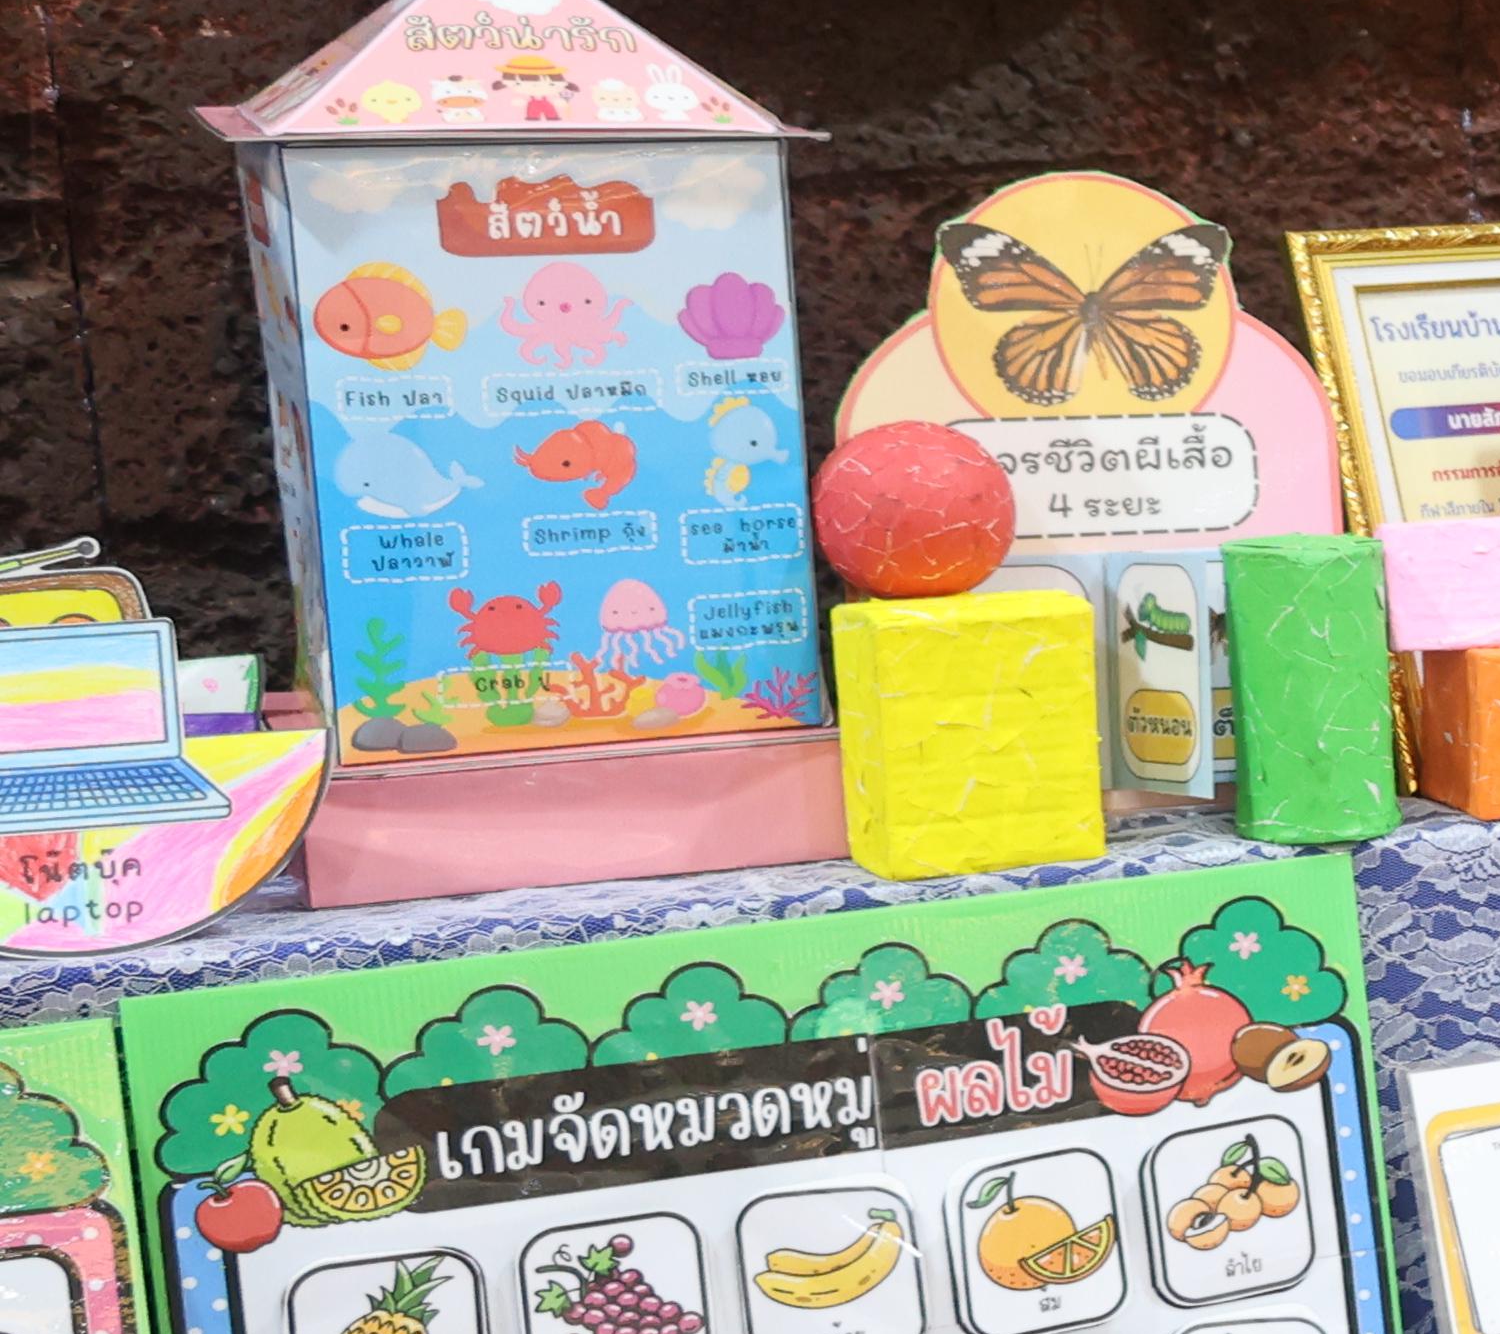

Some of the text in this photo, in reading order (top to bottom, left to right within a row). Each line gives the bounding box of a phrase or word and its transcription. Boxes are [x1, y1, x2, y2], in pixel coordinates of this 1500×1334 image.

[405, 11, 640, 53] สัตว์น่ารัก
[488, 190, 622, 240] สัตว์น้ำ
[688, 369, 783, 388] Shell หอย
[345, 385, 444, 407] Fish ปลา
[497, 379, 648, 404] Squid ปลาหมึก
[1049, 493, 1161, 517] 4 ระยะ
[534, 525, 610, 547] Shrimp
[740, 514, 797, 535] horse
[379, 531, 445, 550] Whale
[704, 599, 794, 622] Jellyfish
[474, 674, 525, 693] Crab
[24, 899, 144, 928] laptop
[437, 1002, 1074, 1180] เกมจัดหมวดหมู่ ผลไม้
